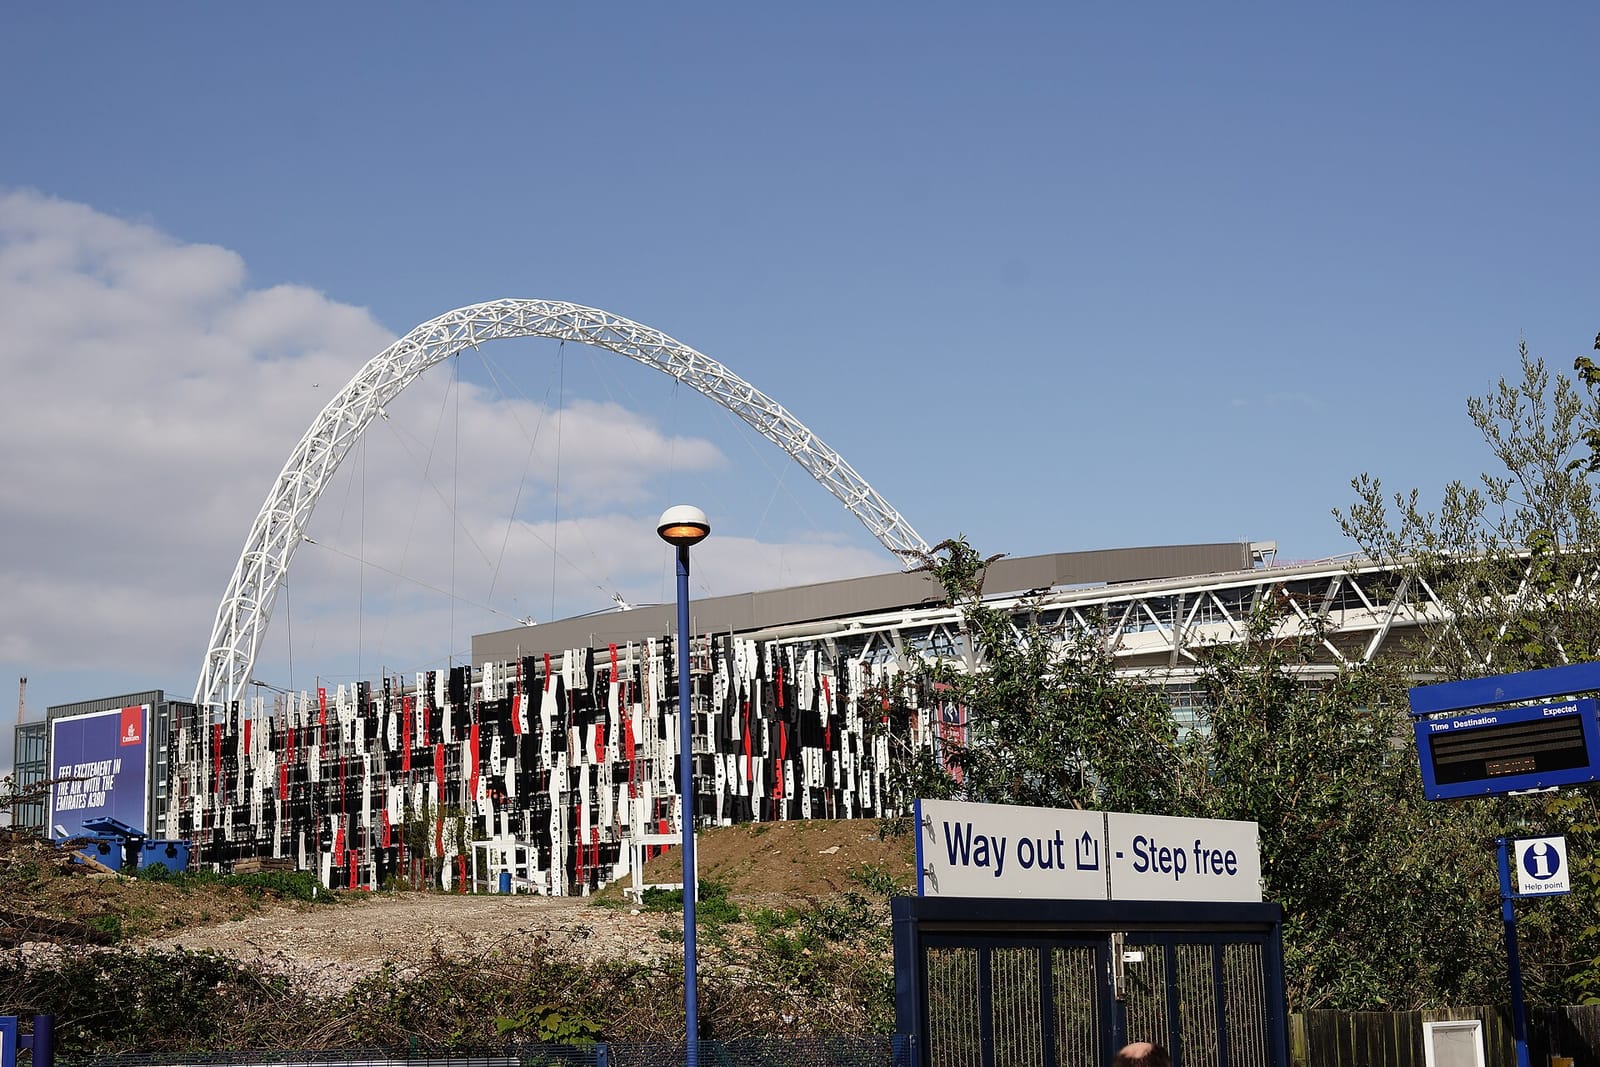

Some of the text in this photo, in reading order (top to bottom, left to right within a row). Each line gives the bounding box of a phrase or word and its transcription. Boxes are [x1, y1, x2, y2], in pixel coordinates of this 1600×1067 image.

[1430, 704, 1577, 731] Time Destination Expected
[74, 760, 112, 778] EXCITEMENT
[113, 759, 121, 774] IN
[58, 780, 70, 796] THE
[83, 777, 100, 793] WITH
[102, 775, 114, 790] THE
[56, 791, 105, 811] EMIRATES A380
[943, 821, 1006, 877] Way
[1017, 829, 1065, 870] out
[1132, 835, 1187, 881] Step
[1193, 839, 1238, 876] free
[1524, 882, 1563, 891] Help point
